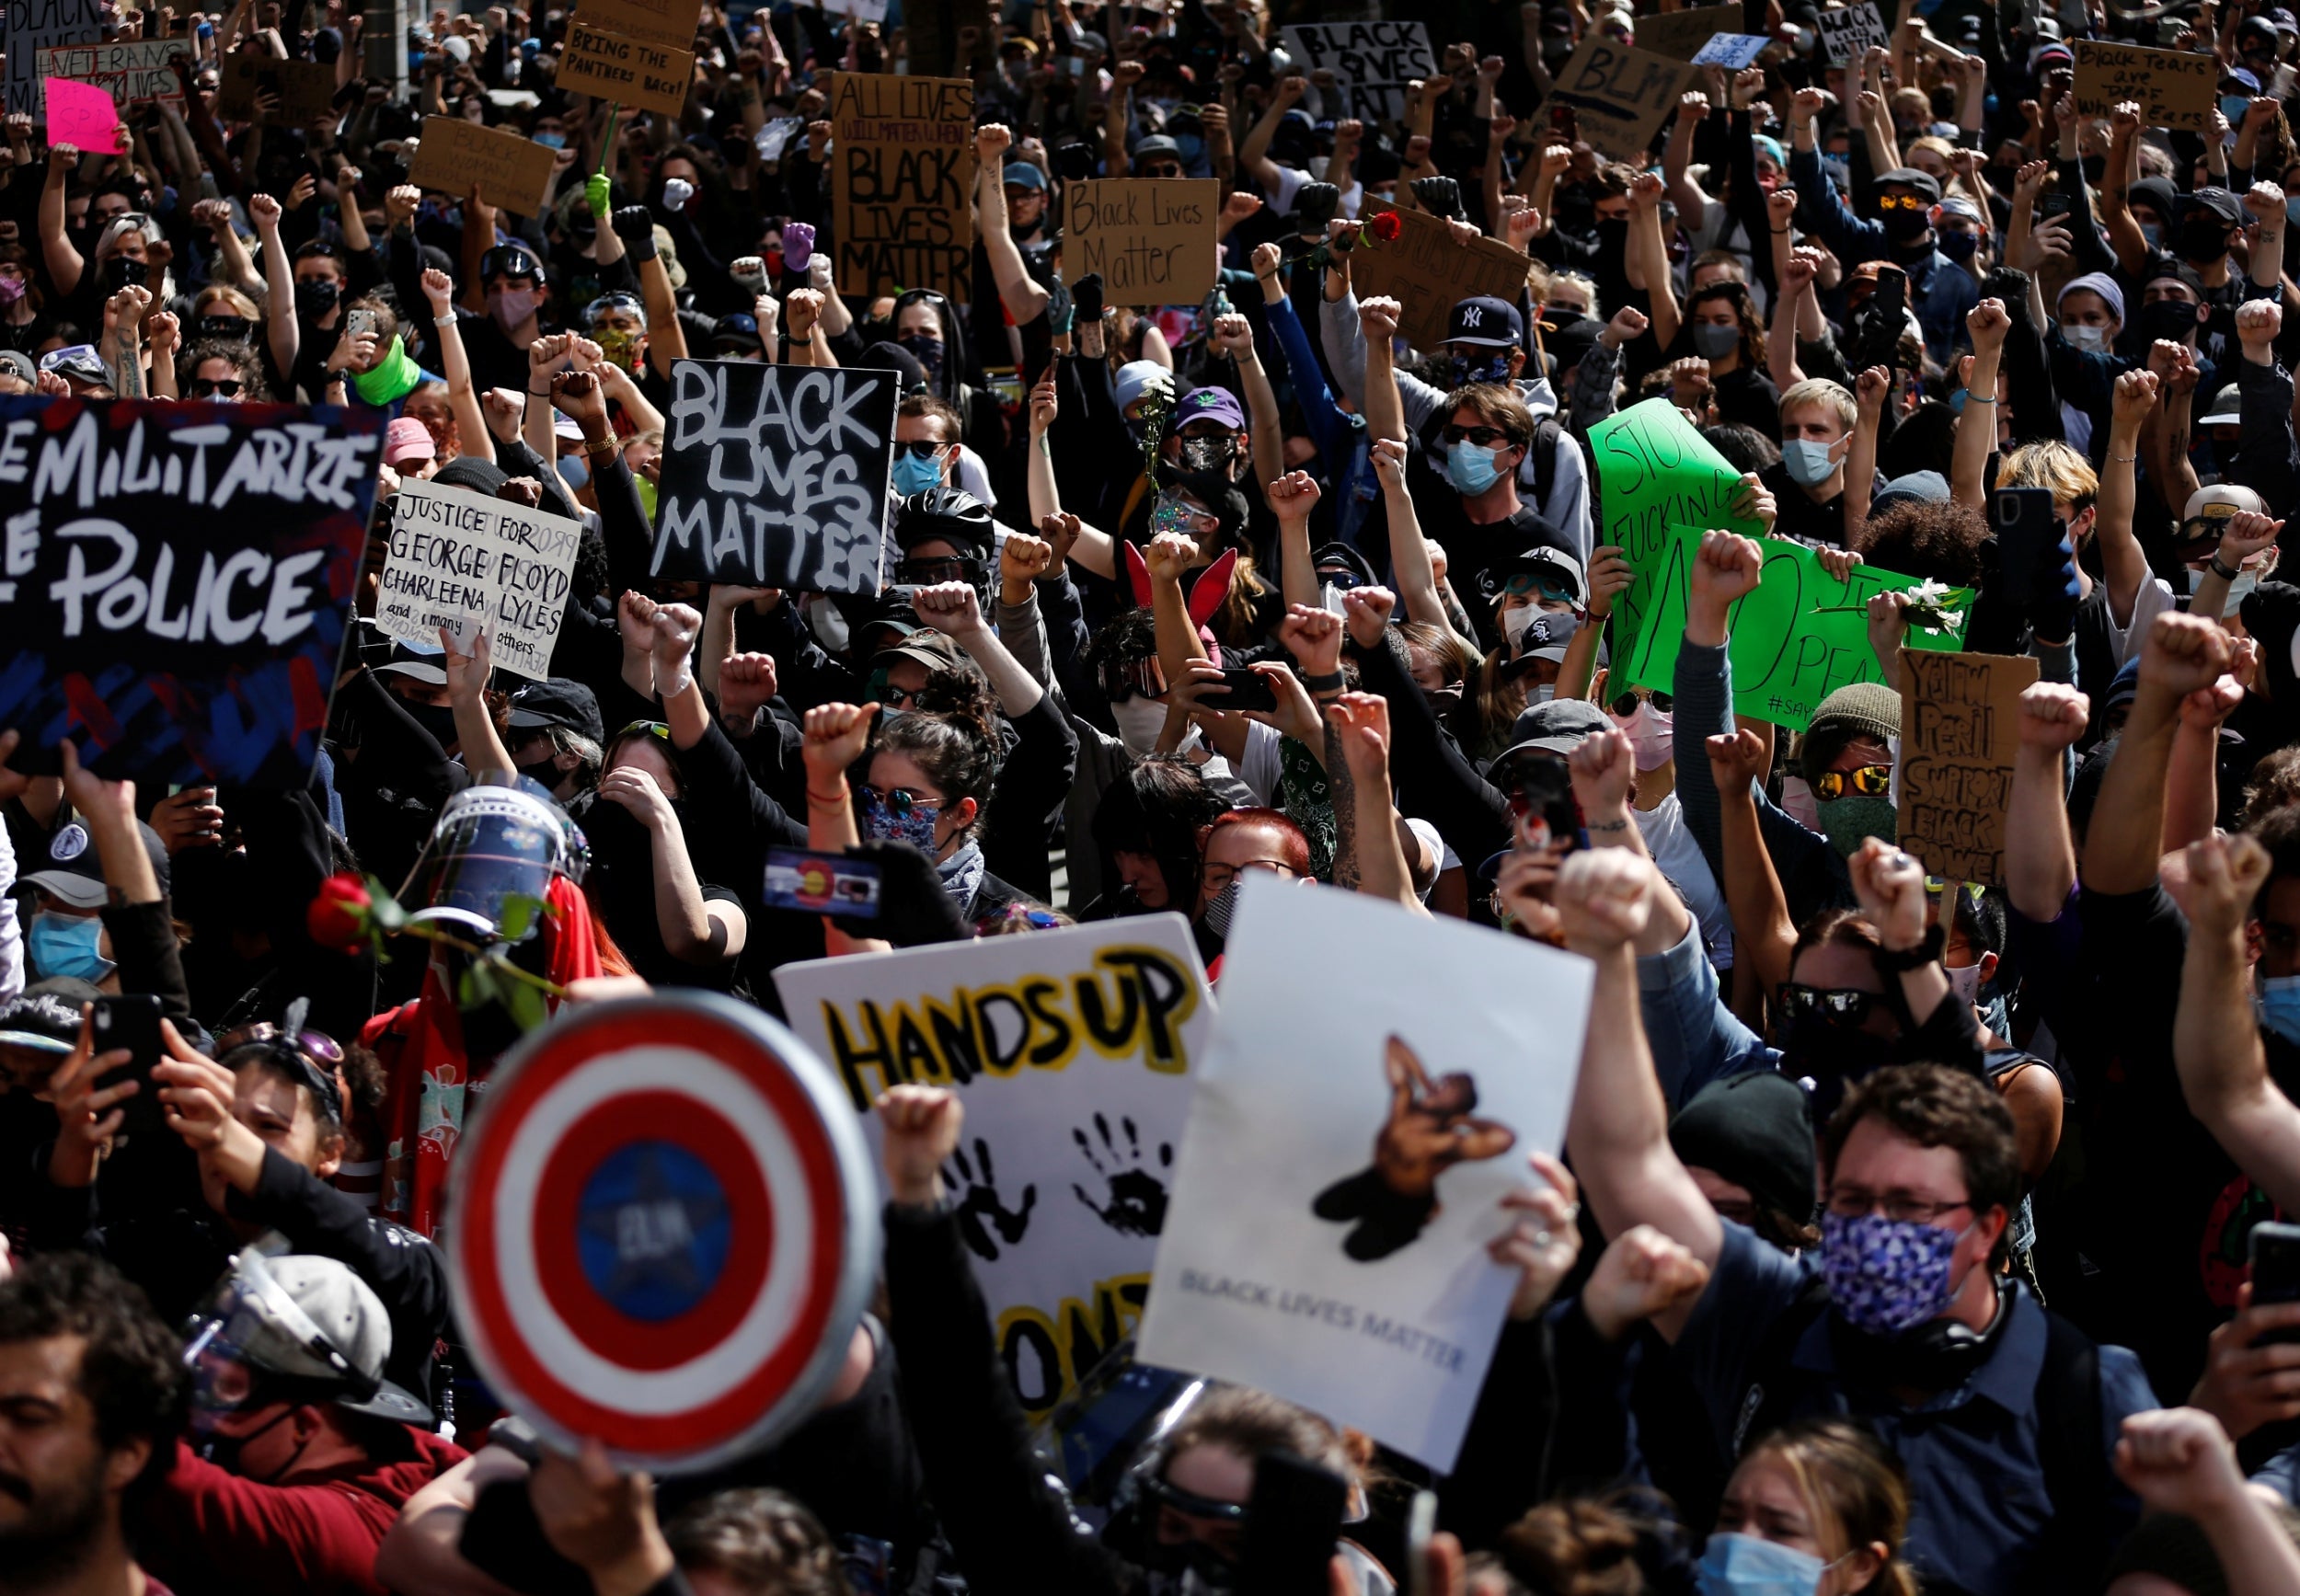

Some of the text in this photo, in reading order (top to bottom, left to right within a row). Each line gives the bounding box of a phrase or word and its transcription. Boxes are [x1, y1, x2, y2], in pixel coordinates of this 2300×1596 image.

[1295, 22, 1422, 54] BLACK
[1819, 3, 1878, 33] BLACK
[566, 52, 635, 83] PANTHERS
[570, 28, 670, 69] BRING THE
[2078, 44, 2206, 75] Black Tears
[834, 77, 972, 122] ALL LIVES
[1573, 46, 1678, 110] BLM
[2113, 71, 2152, 85] are
[842, 120, 878, 141] WILL
[924, 124, 964, 144] WHEN
[2147, 104, 2202, 126] Ears
[454, 127, 517, 162] BLACK
[846, 147, 962, 211] BLACK
[848, 204, 954, 247] LIVES
[1071, 183, 1204, 236] Black Lives
[841, 241, 972, 304] MATTER
[1083, 235, 1185, 290] Matter
[671, 361, 880, 452] BLACK
[0, 410, 379, 511] EMILITARIZE
[1604, 403, 1698, 495] STOP
[707, 442, 873, 529] LIVES
[401, 493, 540, 554] JUSTICE FOR
[1613, 468, 1732, 563] FUCKING
[389, 529, 569, 603] GEORGE FLOYD
[650, 496, 881, 594] MATTER
[49, 517, 327, 647] POLICE
[383, 567, 562, 635] CHARLEENA LYLES
[386, 603, 535, 656] and many others
[1768, 694, 1817, 721] #SAY
[1179, 1267, 1467, 1373] BLACK LIVES MATTER
